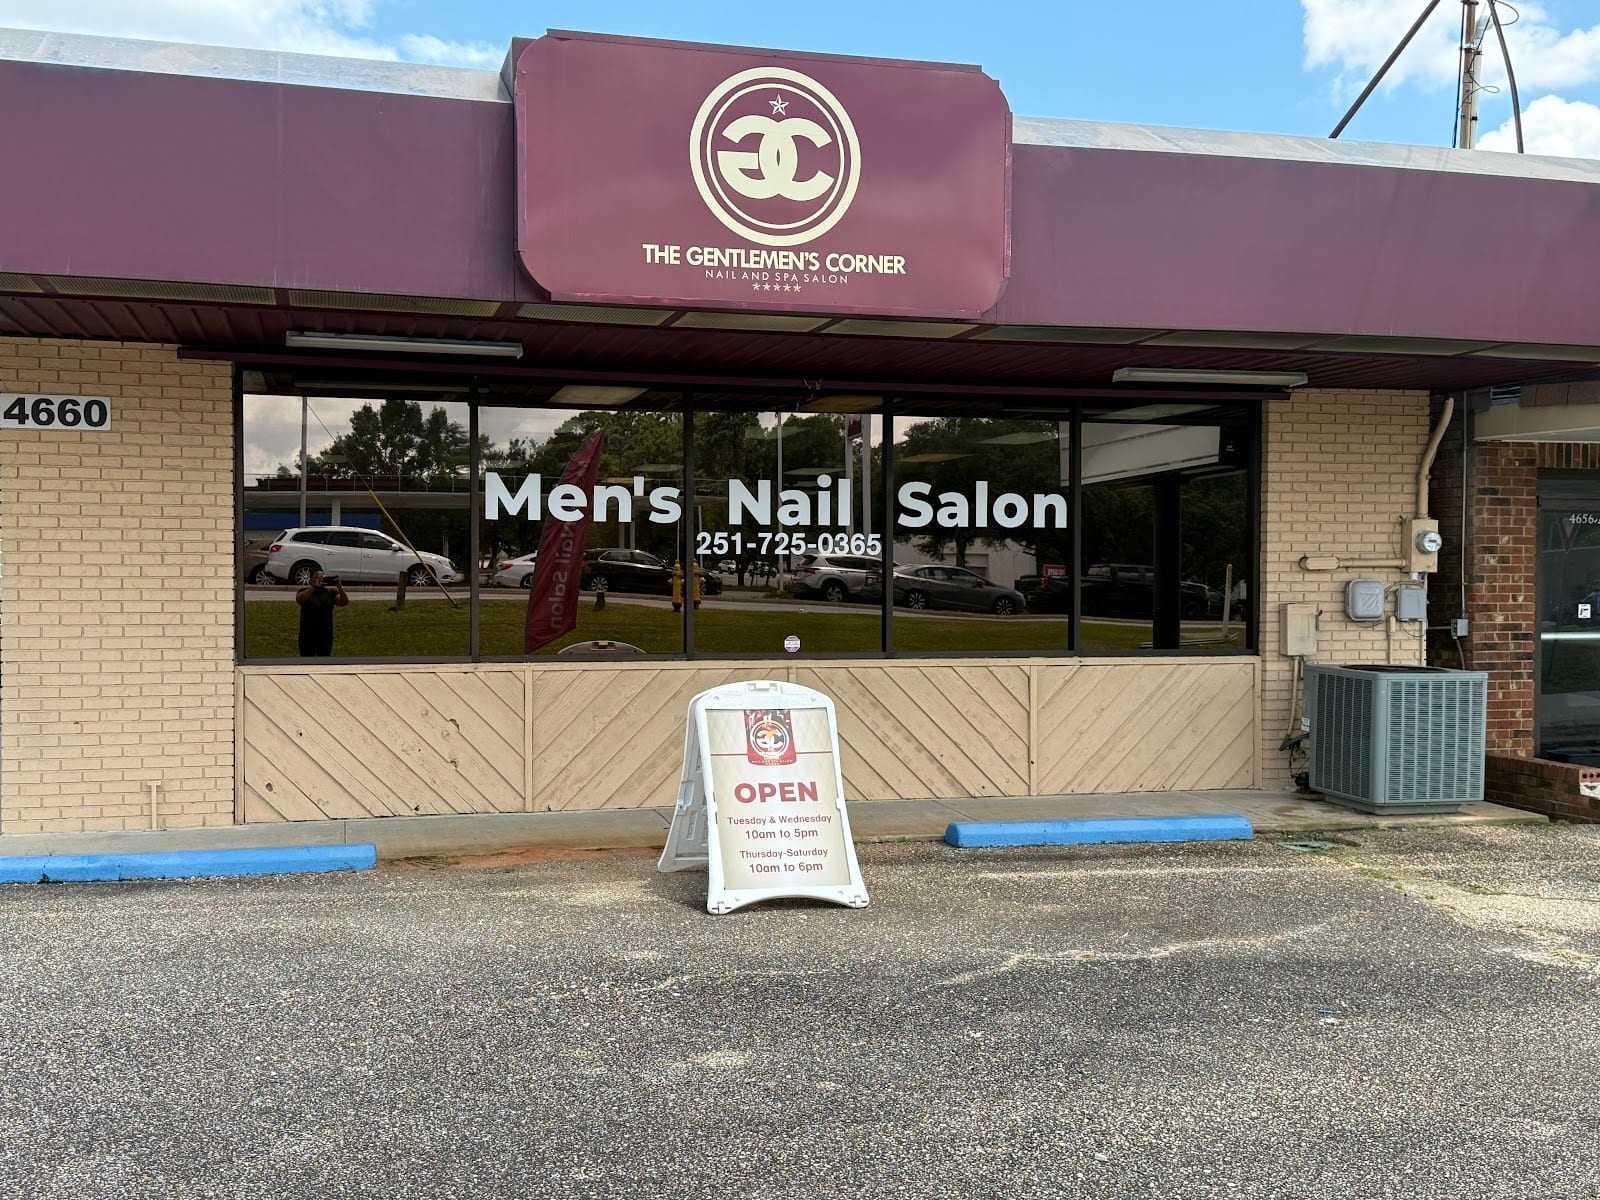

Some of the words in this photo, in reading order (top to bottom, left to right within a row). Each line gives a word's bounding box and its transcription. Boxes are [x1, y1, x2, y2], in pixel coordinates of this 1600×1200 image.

[643, 244, 680, 265] THE
[686, 247, 819, 271] GENTLEMEN'S
[826, 254, 906, 275] CORNER
[705, 270, 737, 280] NAIL
[741, 272, 770, 281] AND
[775, 273, 798, 282] SPA
[803, 274, 849, 284] SALON
[3, 397, 108, 427] 4660
[484, 471, 682, 524] Men's
[728, 474, 851, 527] Nail
[898, 480, 1068, 529] Salon
[696, 532, 882, 556] 251-725-0365
[734, 781, 818, 804] OPEN
[727, 816, 767, 826] Tuesday
[769, 816, 776, 824] &
[778, 814, 832, 825] Wednesday
[745, 830, 776, 840] 10am
[779, 829, 791, 839] to
[794, 828, 818, 840] 5pm
[740, 848, 828, 860] Thursday-Saturday
[750, 863, 781, 873] 10am
[784, 862, 796, 872] to
[799, 862, 823, 874] 6pm
